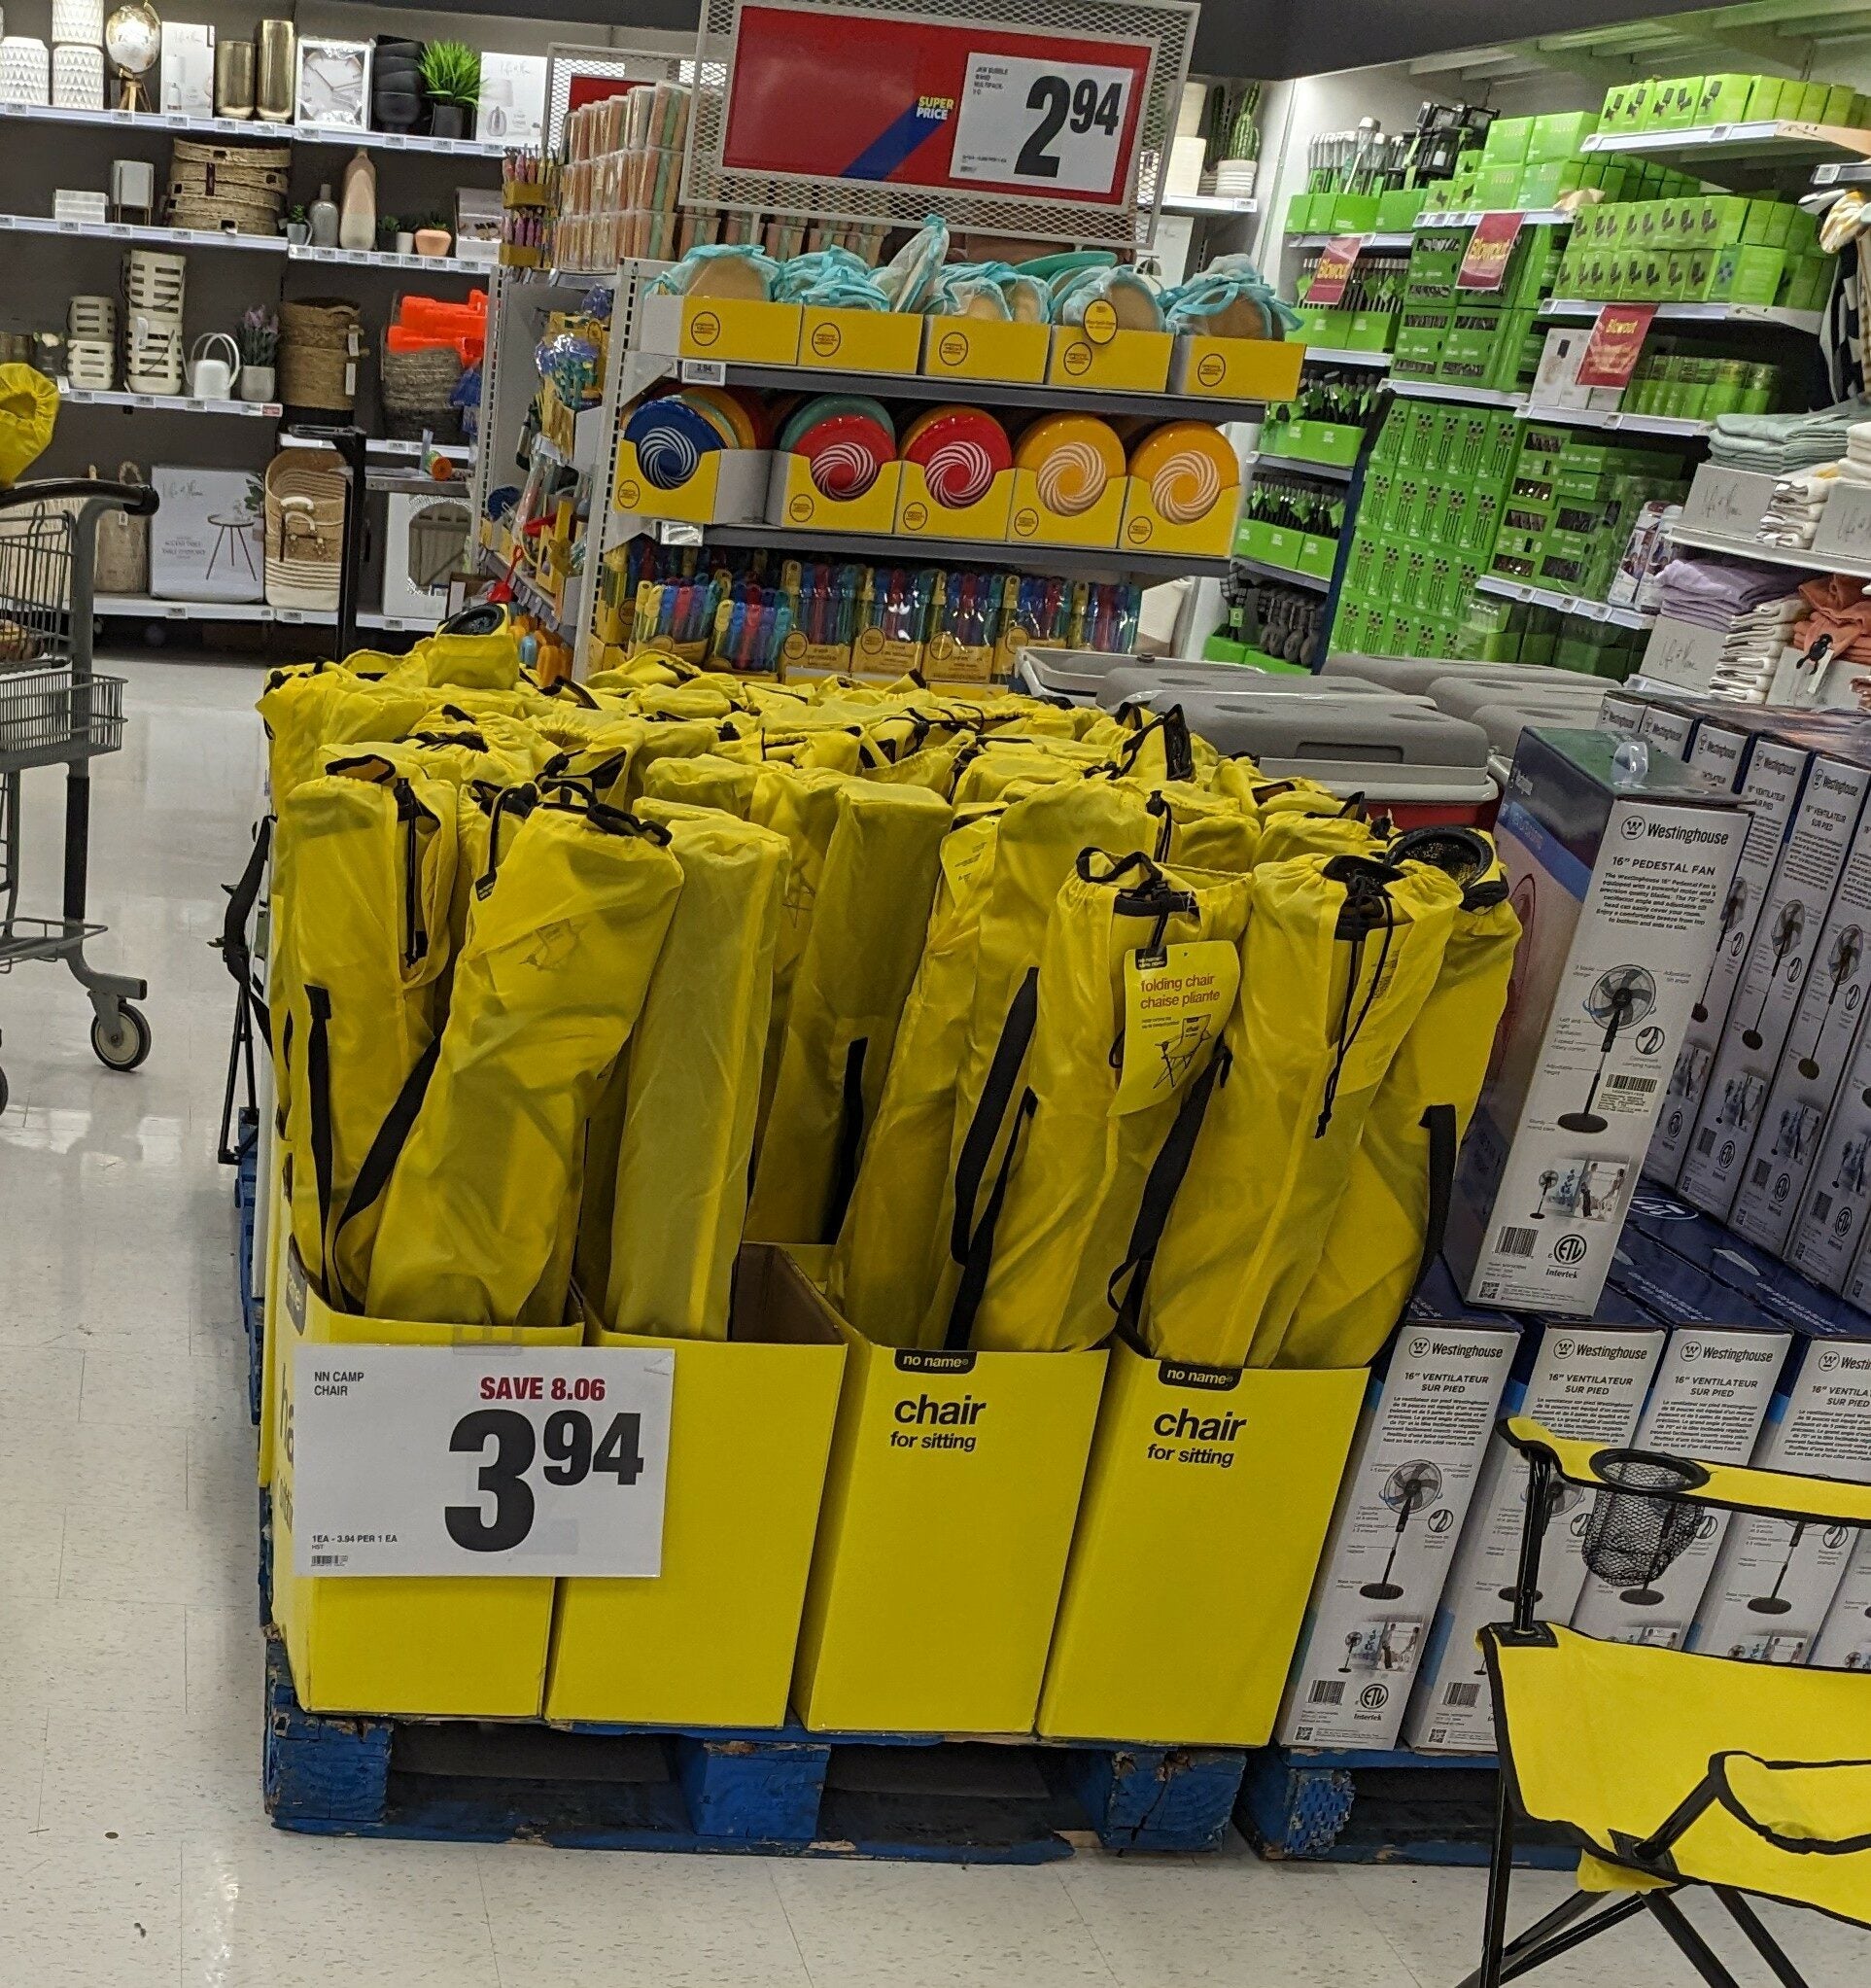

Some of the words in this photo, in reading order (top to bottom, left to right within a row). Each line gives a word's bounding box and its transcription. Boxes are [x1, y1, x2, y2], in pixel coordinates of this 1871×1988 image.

[918, 96, 954, 109] SUPER
[916, 107, 949, 120] PRICE
[1814, 807, 1847, 823] VENTILATEUR
[1647, 822, 1730, 845] Westinghouse
[1632, 859, 1689, 873] PEDESTAL
[1692, 866, 1716, 875] FAN
[1141, 978, 1182, 992] folding
[1186, 973, 1214, 987] chair
[1140, 994, 1179, 1009] chaise
[1181, 990, 1220, 1007] pliante
[1559, 1238, 1583, 1261] ETL
[1546, 1268, 1578, 1279] Intertek
[1432, 1343, 1503, 1358] Westinghouse
[1576, 1344, 1647, 1360] Westinghouse
[1703, 1347, 1773, 1362] Westinghouse
[903, 1355, 921, 1366] no
[314, 1371, 330, 1382] NN
[332, 1372, 364, 1383] CAMP
[1167, 1369, 1185, 1380] no
[1423, 1373, 1490, 1383] VENTILATEUR
[1567, 1374, 1633, 1385] VENTILATEUR
[480, 1377, 544, 1400] SAVE
[551, 1378, 606, 1401] 8.06
[1565, 1385, 1584, 1394] SUR
[1693, 1377, 1758, 1388] VENTILATEUR
[314, 1385, 348, 1396] CHAIR
[895, 1394, 987, 1425] chair
[1154, 1408, 1247, 1441] chair
[890, 1431, 918, 1447] for
[921, 1433, 976, 1452] sitting
[1147, 1444, 1175, 1460] for
[1178, 1447, 1234, 1468] sitting
[312, 1535, 329, 1543] 1EA
[337, 1535, 355, 1543] 3.94
[357, 1535, 375, 1543] PER
[385, 1535, 398, 1543] EA
